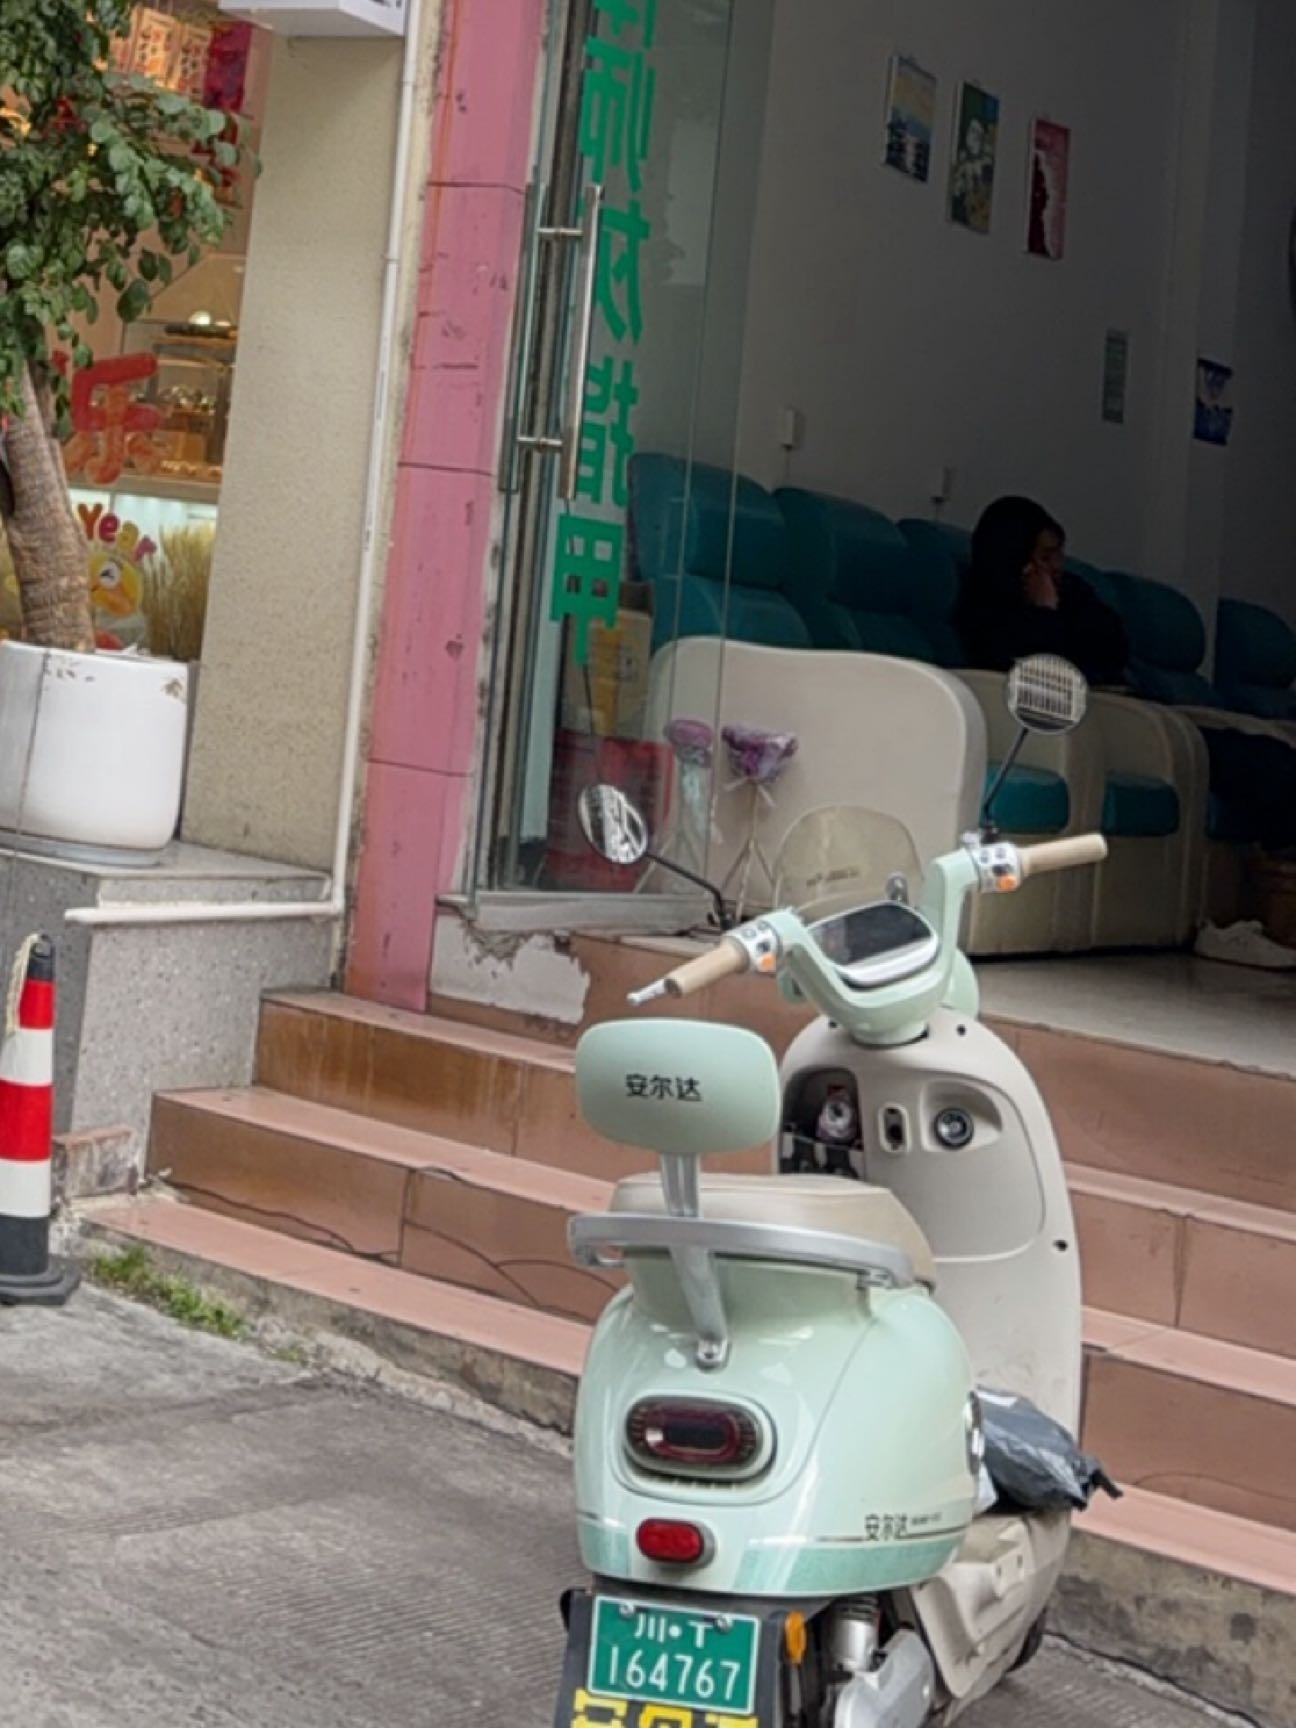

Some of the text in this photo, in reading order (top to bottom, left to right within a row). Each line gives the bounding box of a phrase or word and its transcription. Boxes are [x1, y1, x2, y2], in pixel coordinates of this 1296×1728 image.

[626, 1073, 702, 1102] 安尔达
[608, 1645, 741, 1701] 164767
